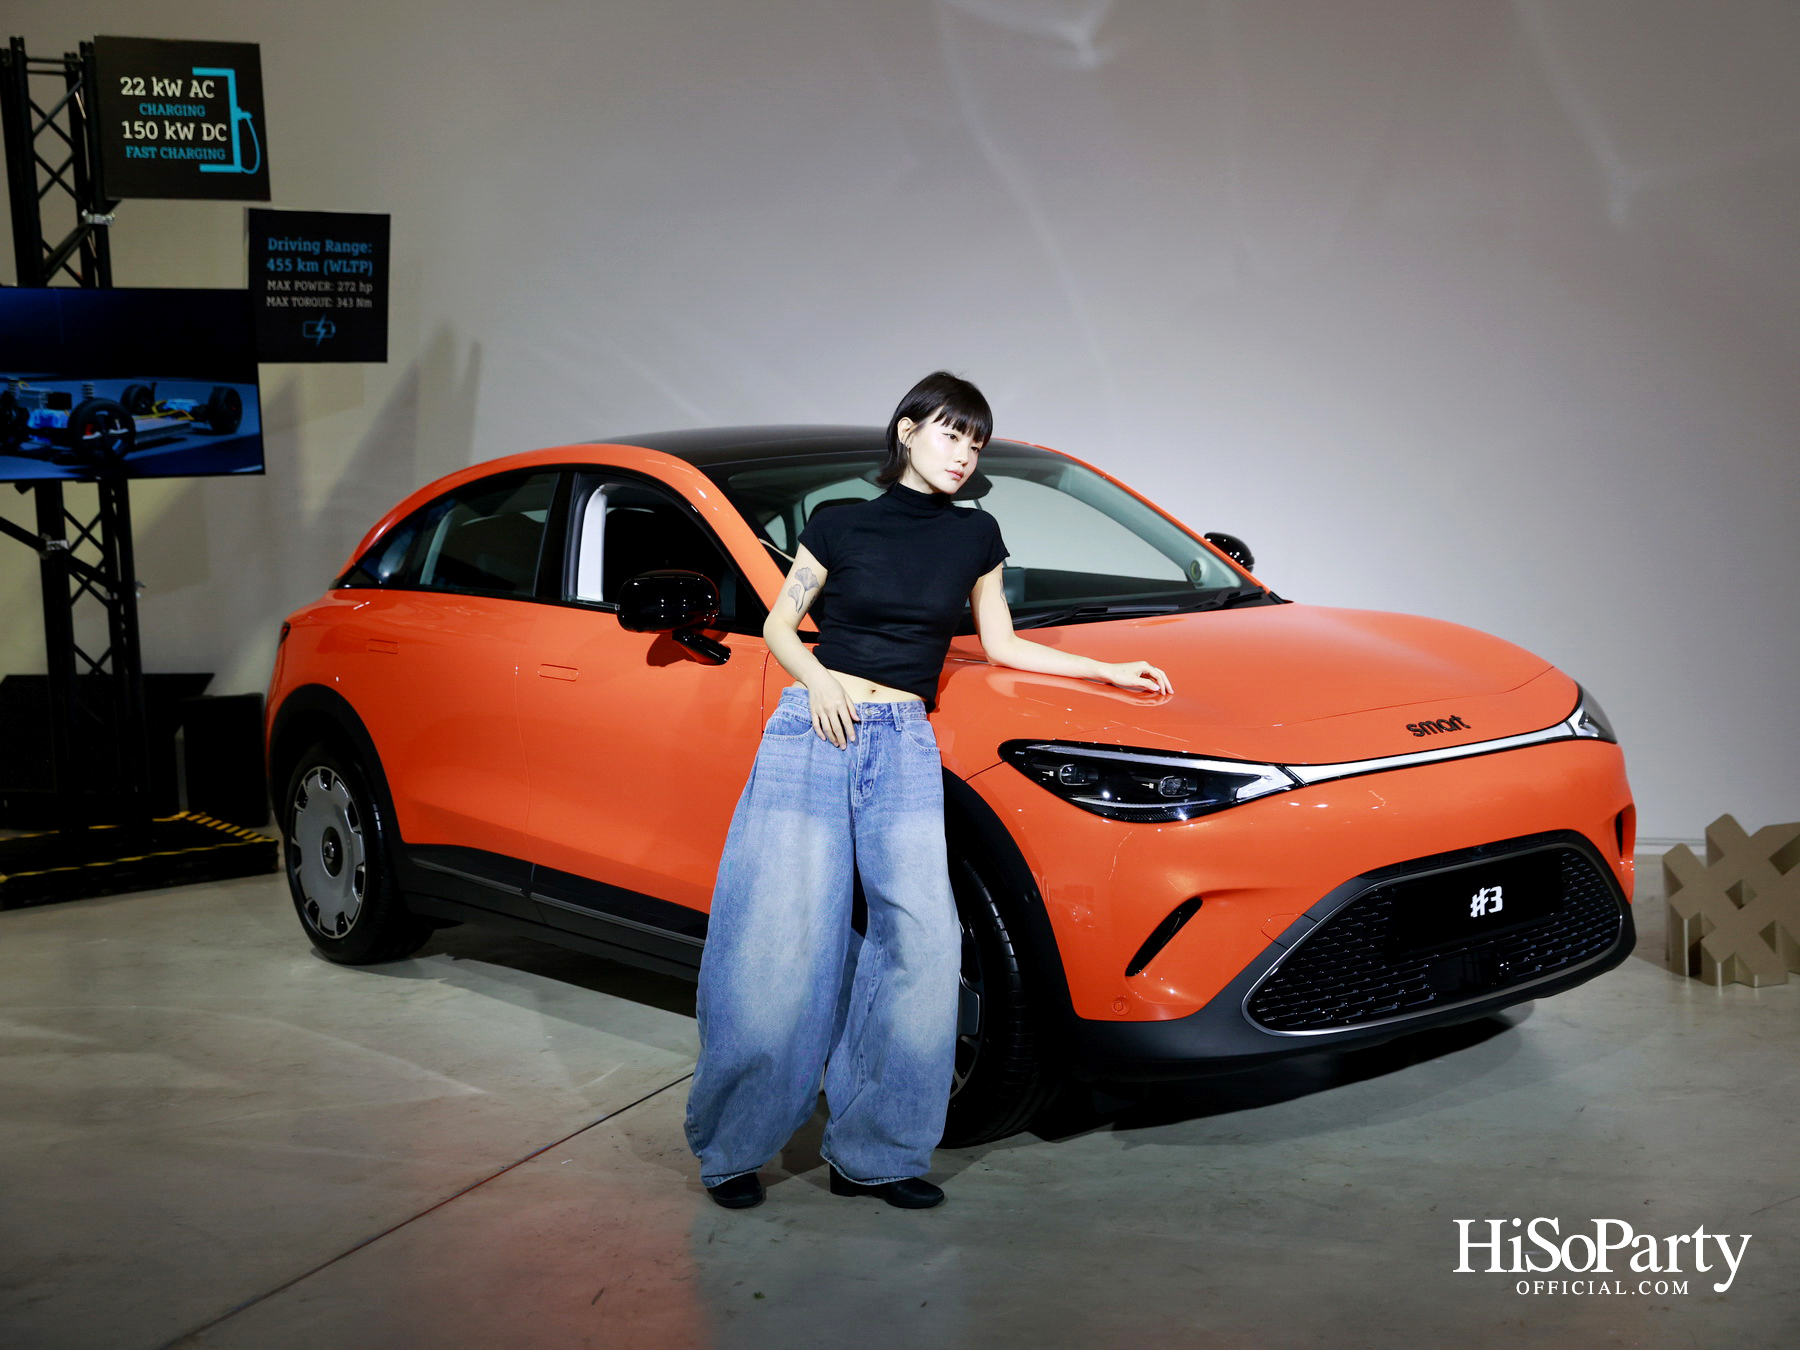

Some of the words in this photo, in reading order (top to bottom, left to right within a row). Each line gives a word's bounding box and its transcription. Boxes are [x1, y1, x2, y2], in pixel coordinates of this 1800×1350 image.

[120, 76, 146, 96] 22
[151, 76, 183, 98] kW
[189, 79, 215, 99] AC
[139, 102, 206, 118] CHARGING
[122, 120, 159, 140] 150
[164, 120, 195, 141] kW
[201, 122, 228, 142] DC
[126, 145, 157, 159] FAST
[160, 146, 226, 161] CHARGING
[267, 236, 321, 255] Driving
[325, 239, 373, 256] Range:
[266, 257, 293, 272] 455
[297, 257, 319, 273] km
[323, 259, 373, 277] (WLTP)
[267, 279, 291, 291] MAX
[294, 280, 334, 292] POWER:
[337, 281, 356, 292] 272
[359, 281, 373, 294] hp
[266, 296, 289, 307] MAX
[356, 298, 373, 308] Nm
[1406, 714, 1471, 737] smart
[1470, 885, 1503, 918] #3
